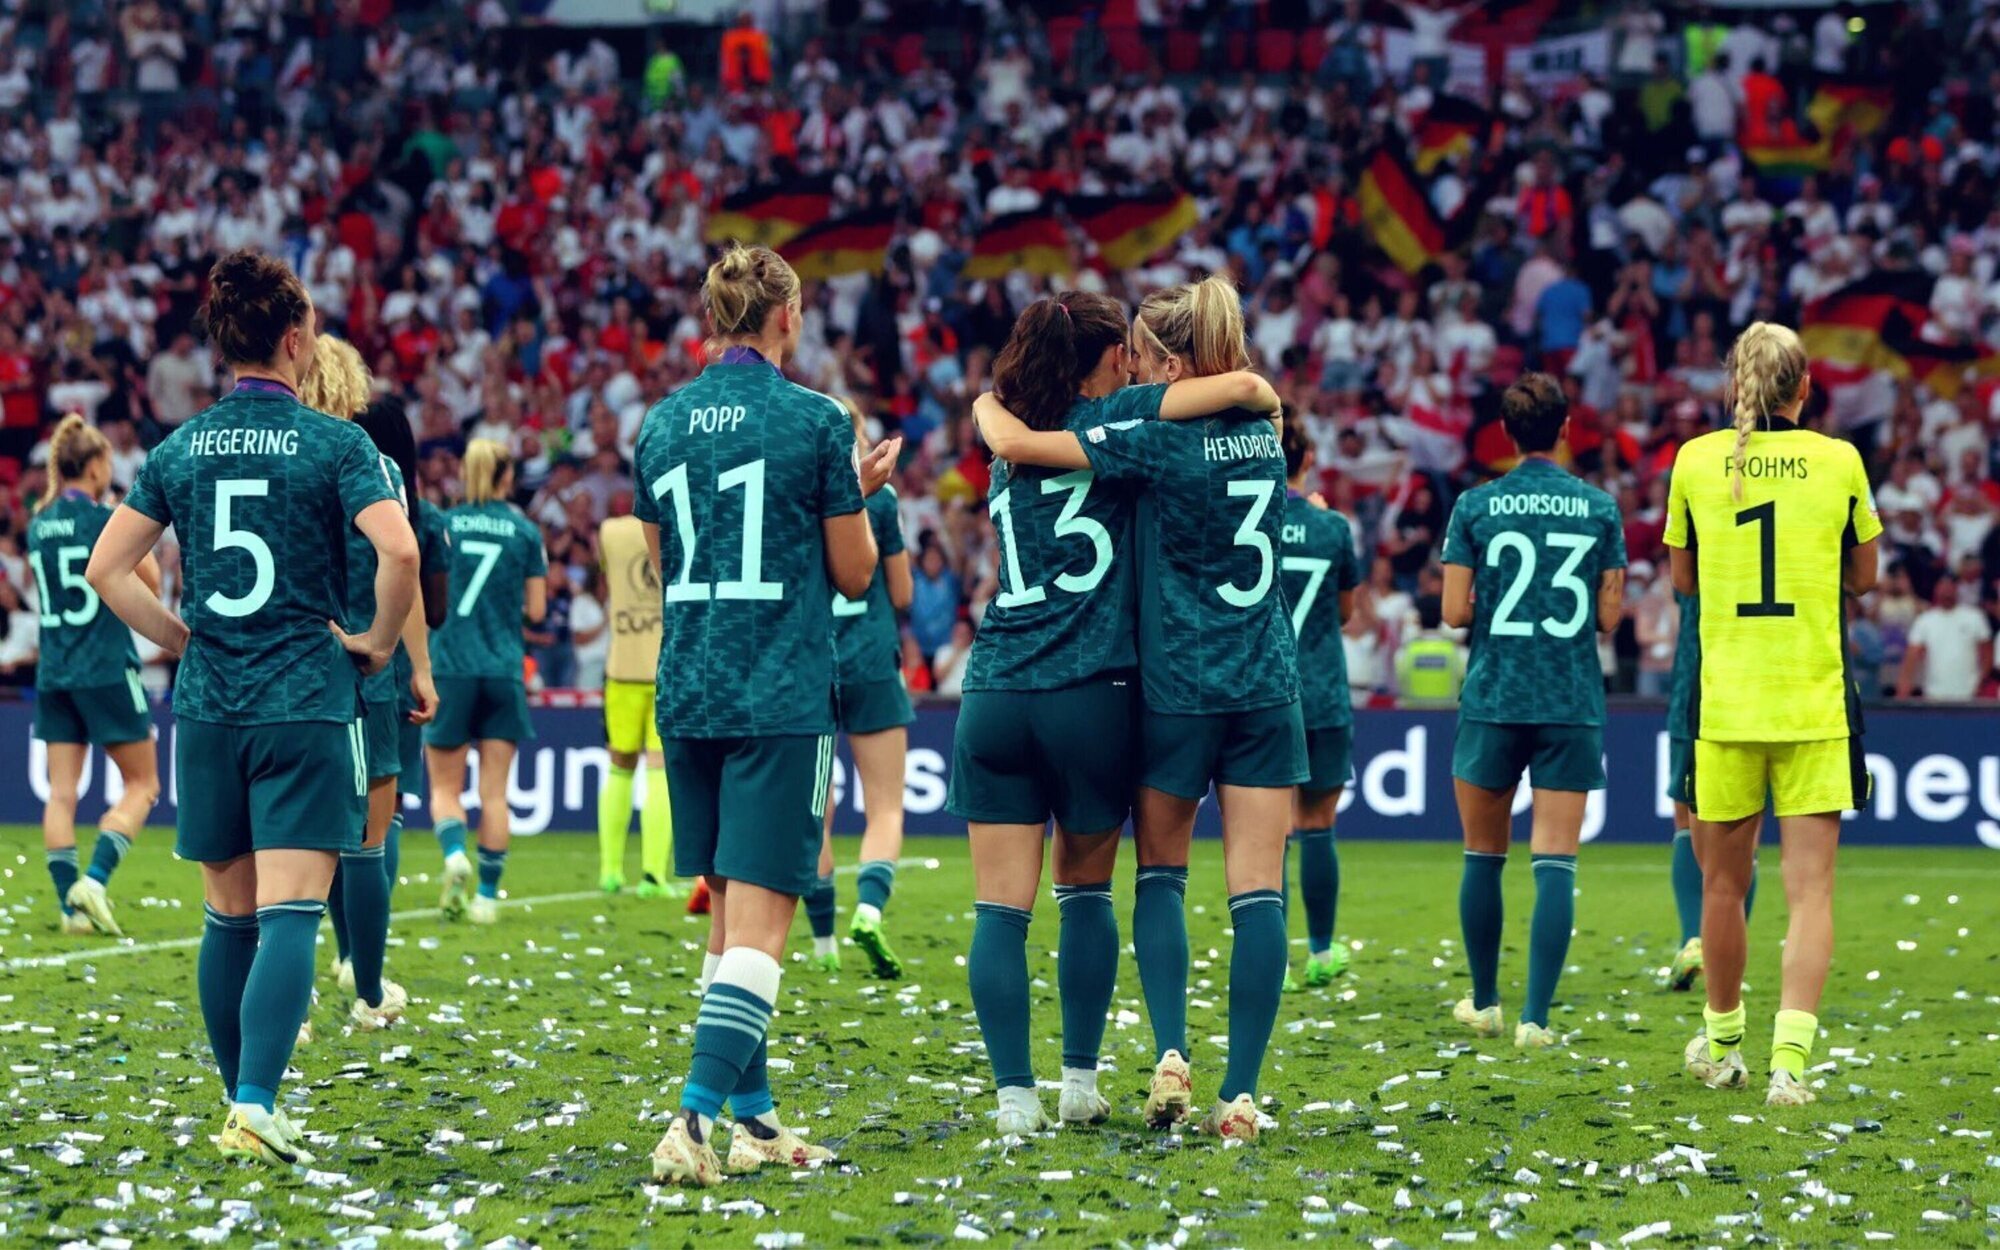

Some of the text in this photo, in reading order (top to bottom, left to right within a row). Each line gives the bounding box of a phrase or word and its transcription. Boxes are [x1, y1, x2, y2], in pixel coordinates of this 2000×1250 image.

[189, 428, 299, 457] HEGERING
[688, 405, 746, 434] POPP
[1204, 434, 1284, 461] HENDRICH
[205, 479, 275, 617] 5
[651, 459, 783, 602] 11
[989, 470, 1113, 608] 13
[1216, 480, 1276, 608] 3
[1489, 494, 1590, 519] DOORSOUN
[28, 545, 100, 628] 15
[457, 540, 502, 617] 7
[1487, 530, 1597, 638] 23
[1735, 500, 1796, 617] 1
